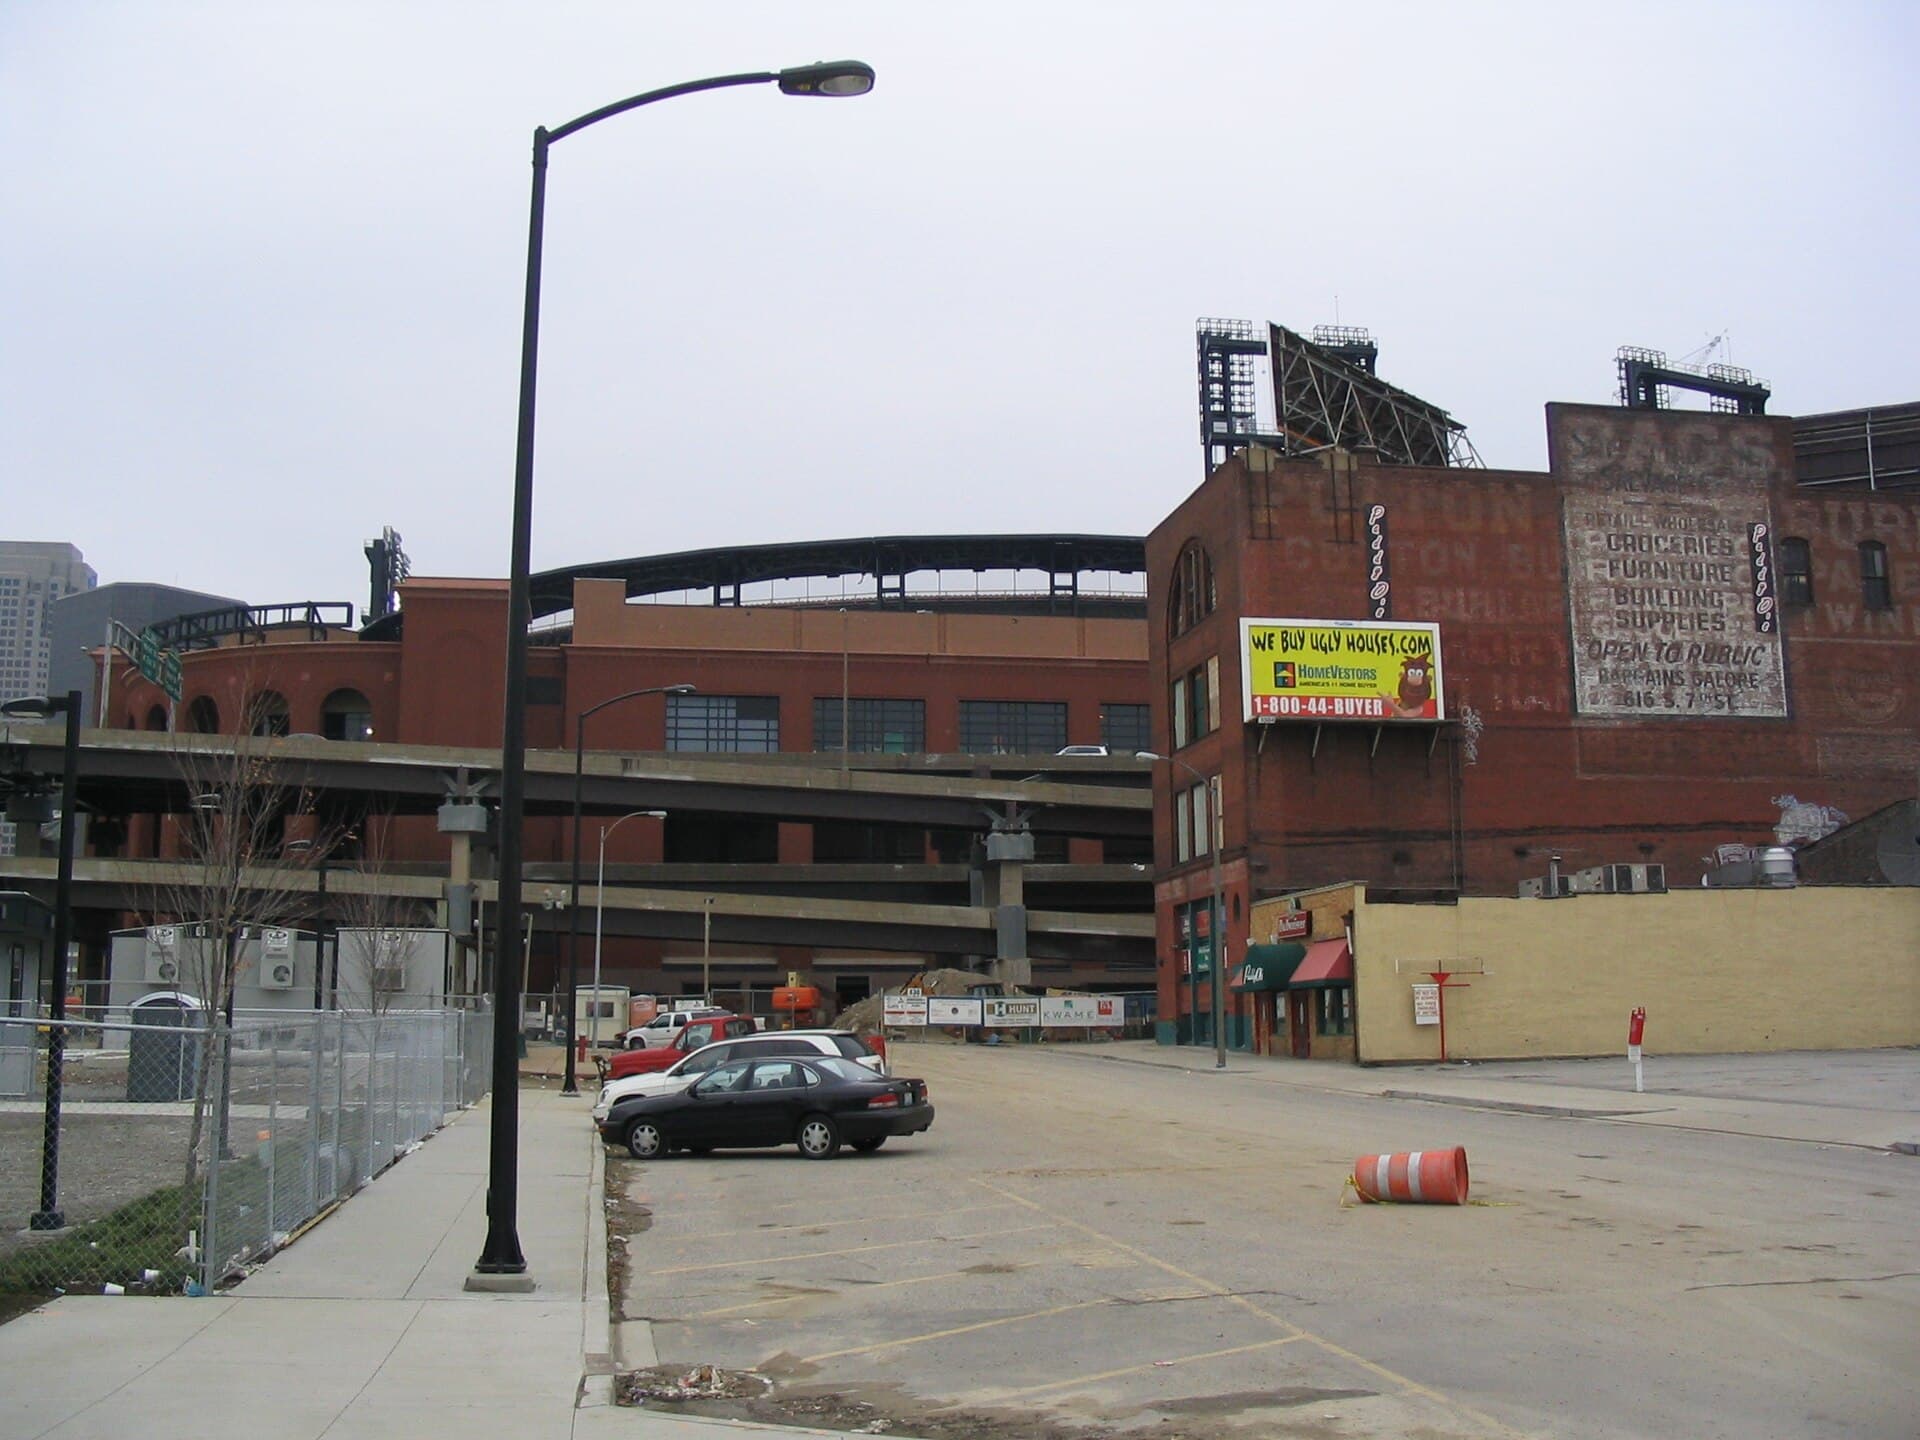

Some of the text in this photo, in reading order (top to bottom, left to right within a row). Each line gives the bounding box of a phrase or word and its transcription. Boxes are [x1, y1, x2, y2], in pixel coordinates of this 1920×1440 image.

[1607, 533, 1734, 556] GROCERIES
[1609, 559, 1732, 582] FURNITURE
[1615, 586, 1727, 609] BUILDING
[1616, 609, 1726, 632] SUPPLIES
[1252, 630, 1431, 656] WE BUY UGLY HOUSES.COM
[1587, 639, 1766, 666] OPEN TO PUBLIC
[1598, 668, 1760, 689] BARGAINS GALORE
[1254, 696, 1383, 716] 1-800-44-BUYER
[1008, 1004, 1036, 1014] HUNT
[1043, 1011, 1096, 1019] KWAME
